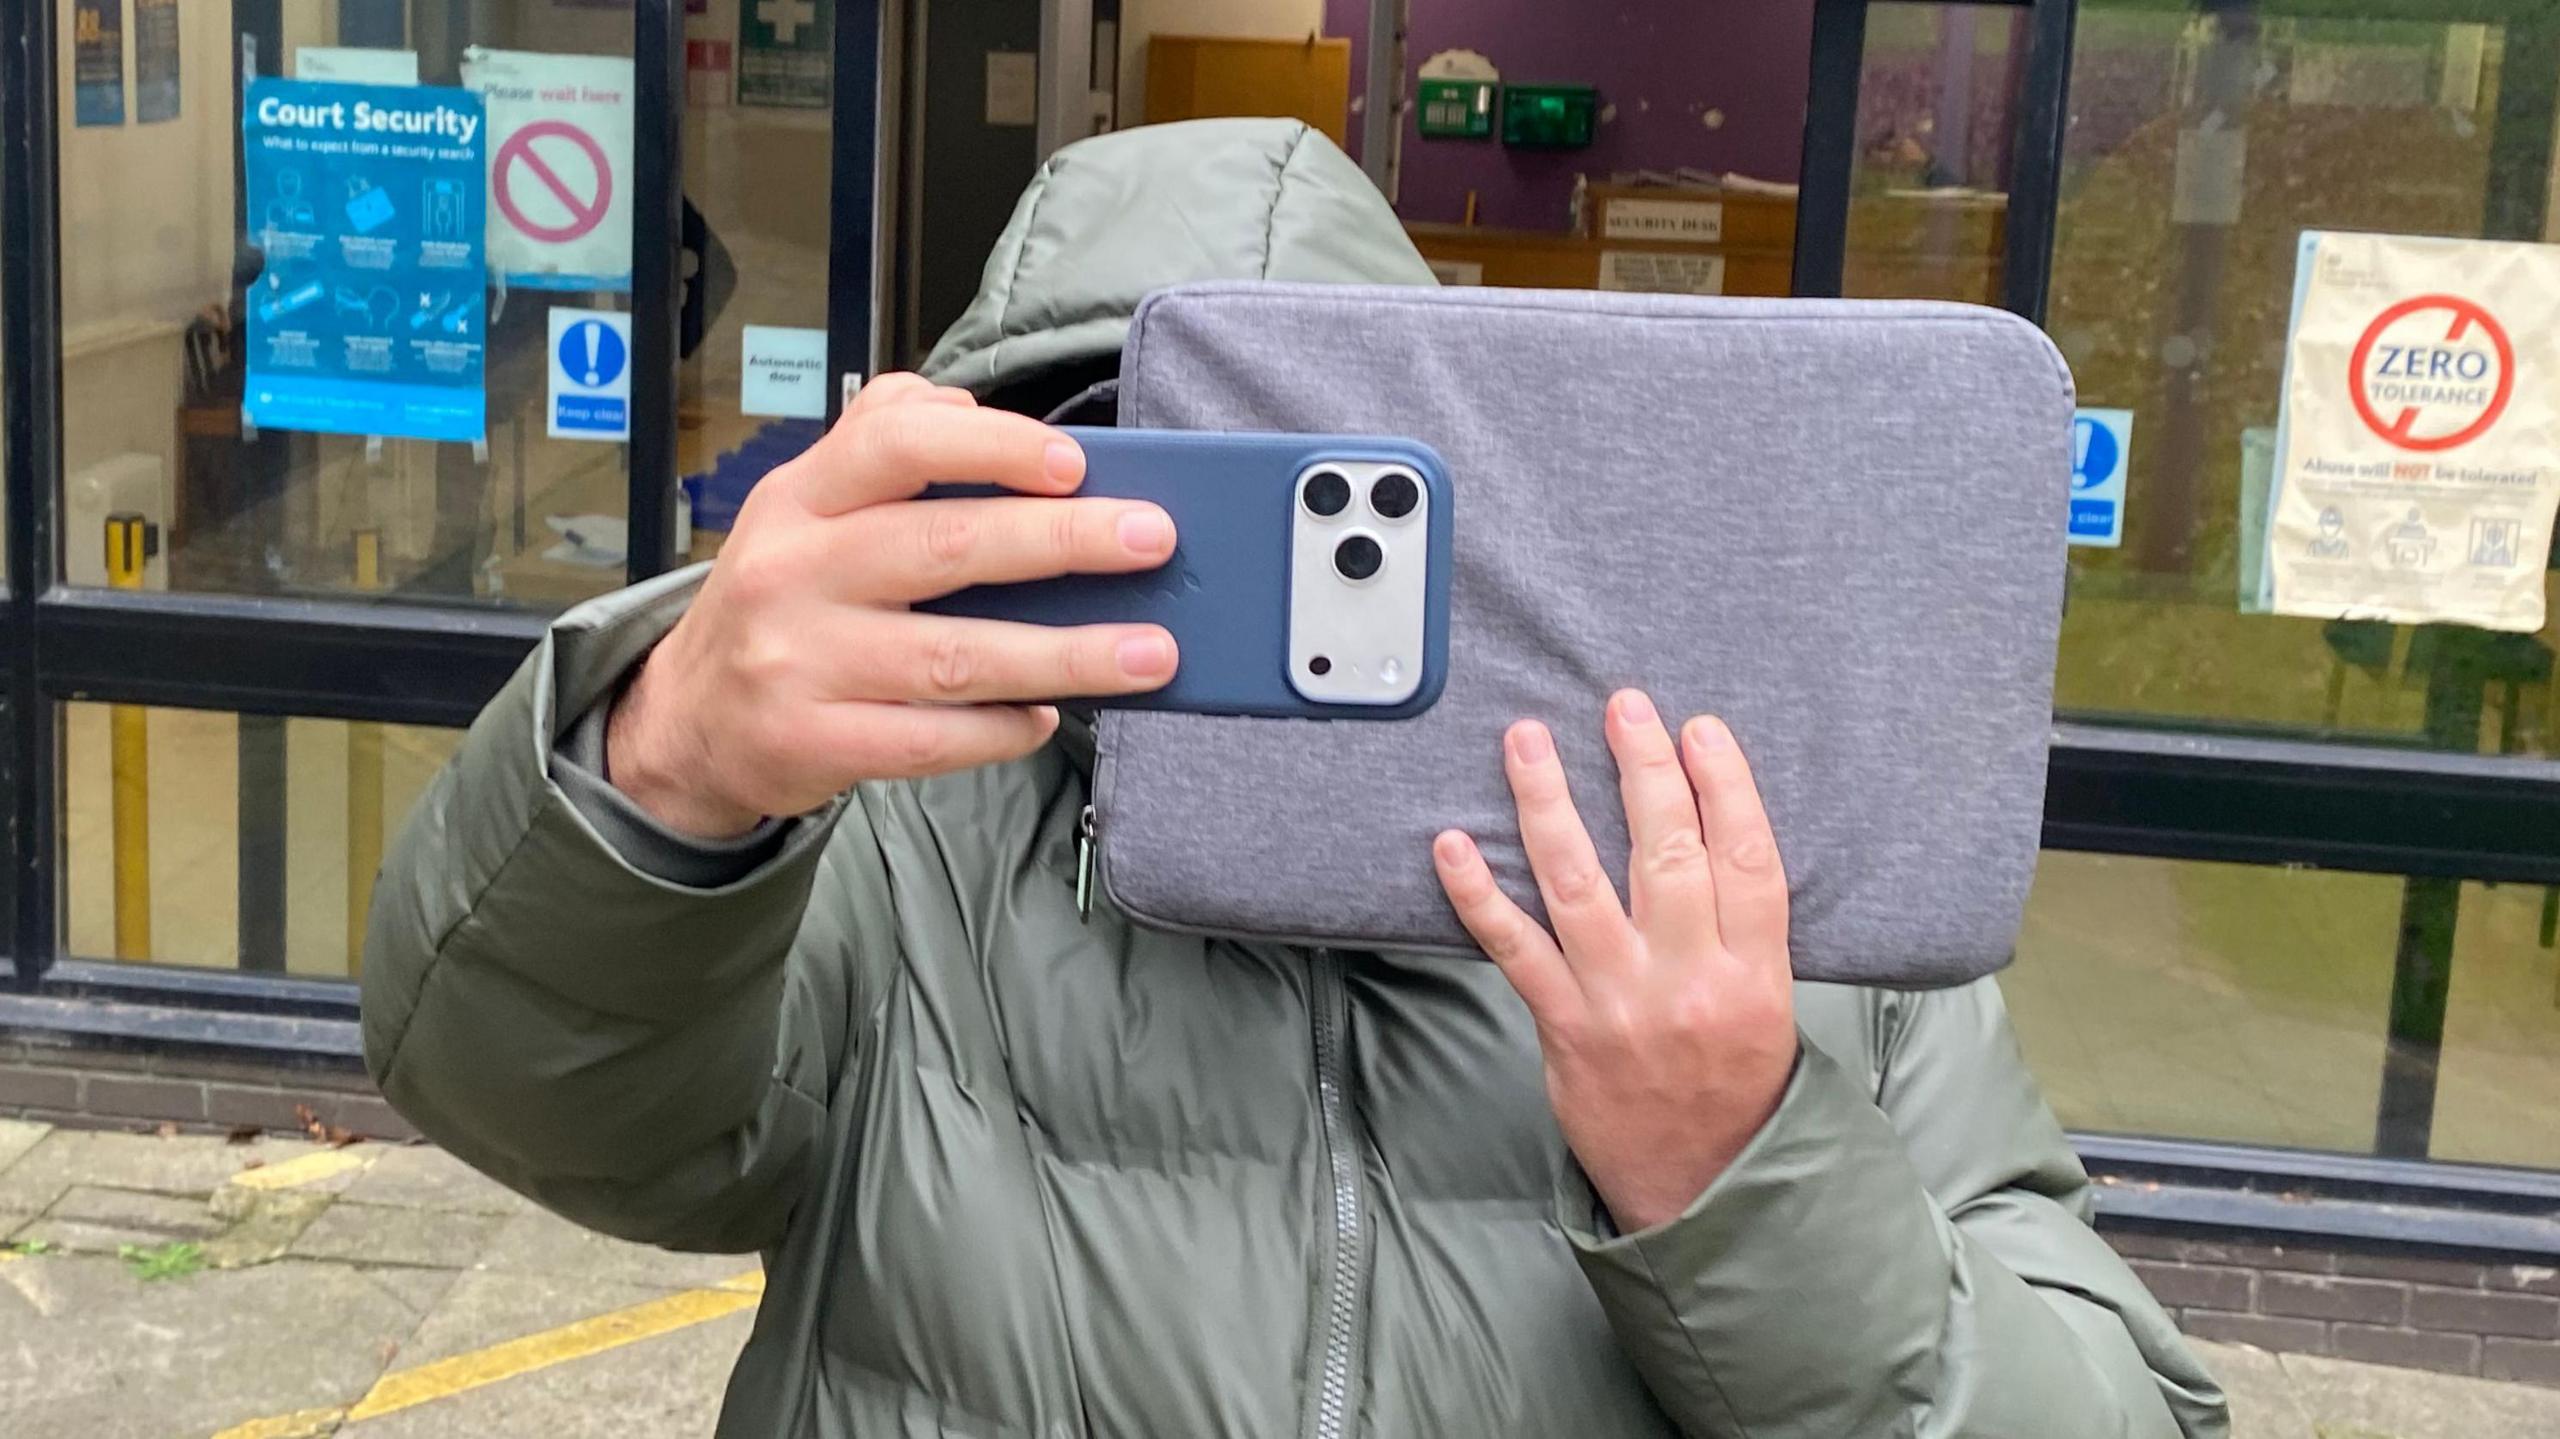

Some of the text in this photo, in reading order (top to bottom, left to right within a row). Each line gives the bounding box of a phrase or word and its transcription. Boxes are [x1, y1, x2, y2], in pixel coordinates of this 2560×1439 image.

[539, 84, 576, 102] wait
[258, 97, 478, 144] Court Security
[263, 136, 475, 160] What to expect from a security search
[749, 354, 822, 370] Automatic
[2376, 345, 2488, 380] ZERO
[769, 372, 801, 383] door
[2371, 383, 2488, 405] TOLERANCE
[558, 405, 623, 421] Keep clear
[2303, 457, 2537, 486] Abuse will NOT be tolerated
